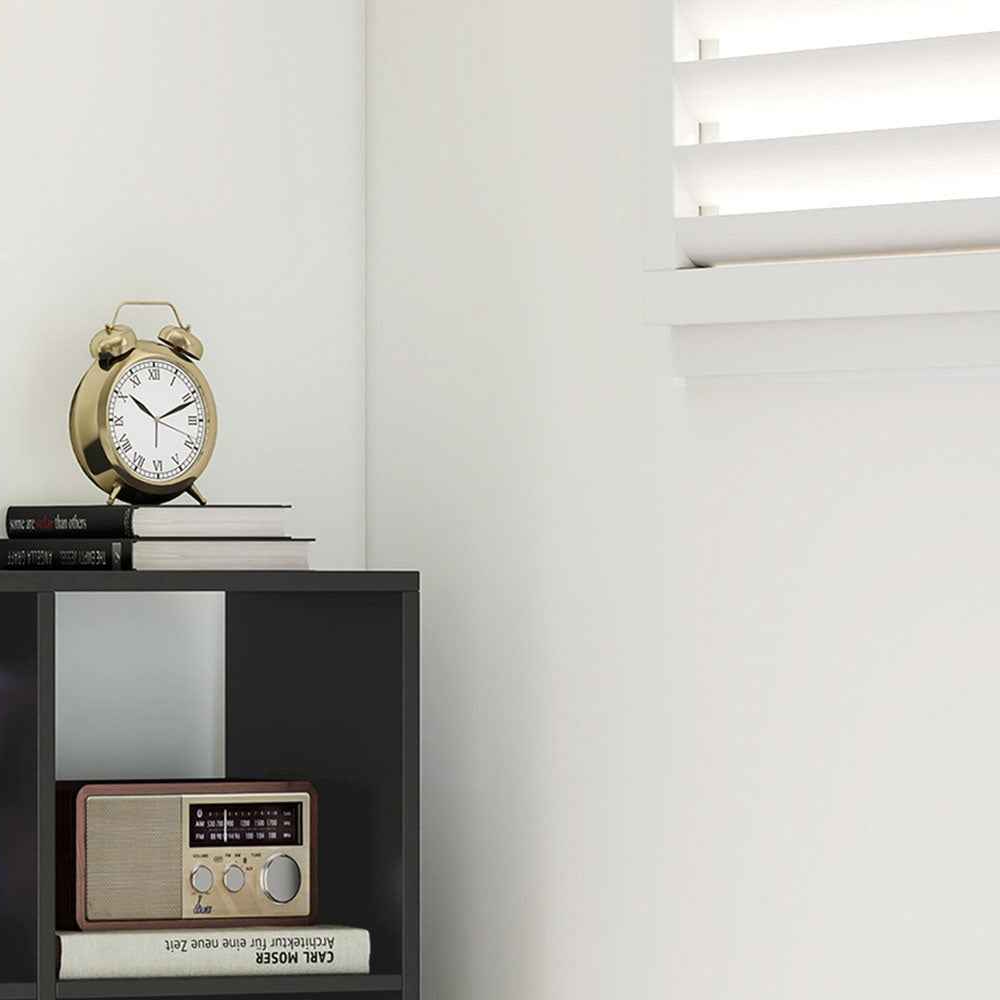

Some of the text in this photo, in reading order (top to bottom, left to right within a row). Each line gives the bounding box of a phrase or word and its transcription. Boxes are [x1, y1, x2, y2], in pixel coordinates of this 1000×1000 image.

[164, 936, 335, 953] Architektur für eine neue Zeit
[255, 951, 335, 965] CARL MOSER
